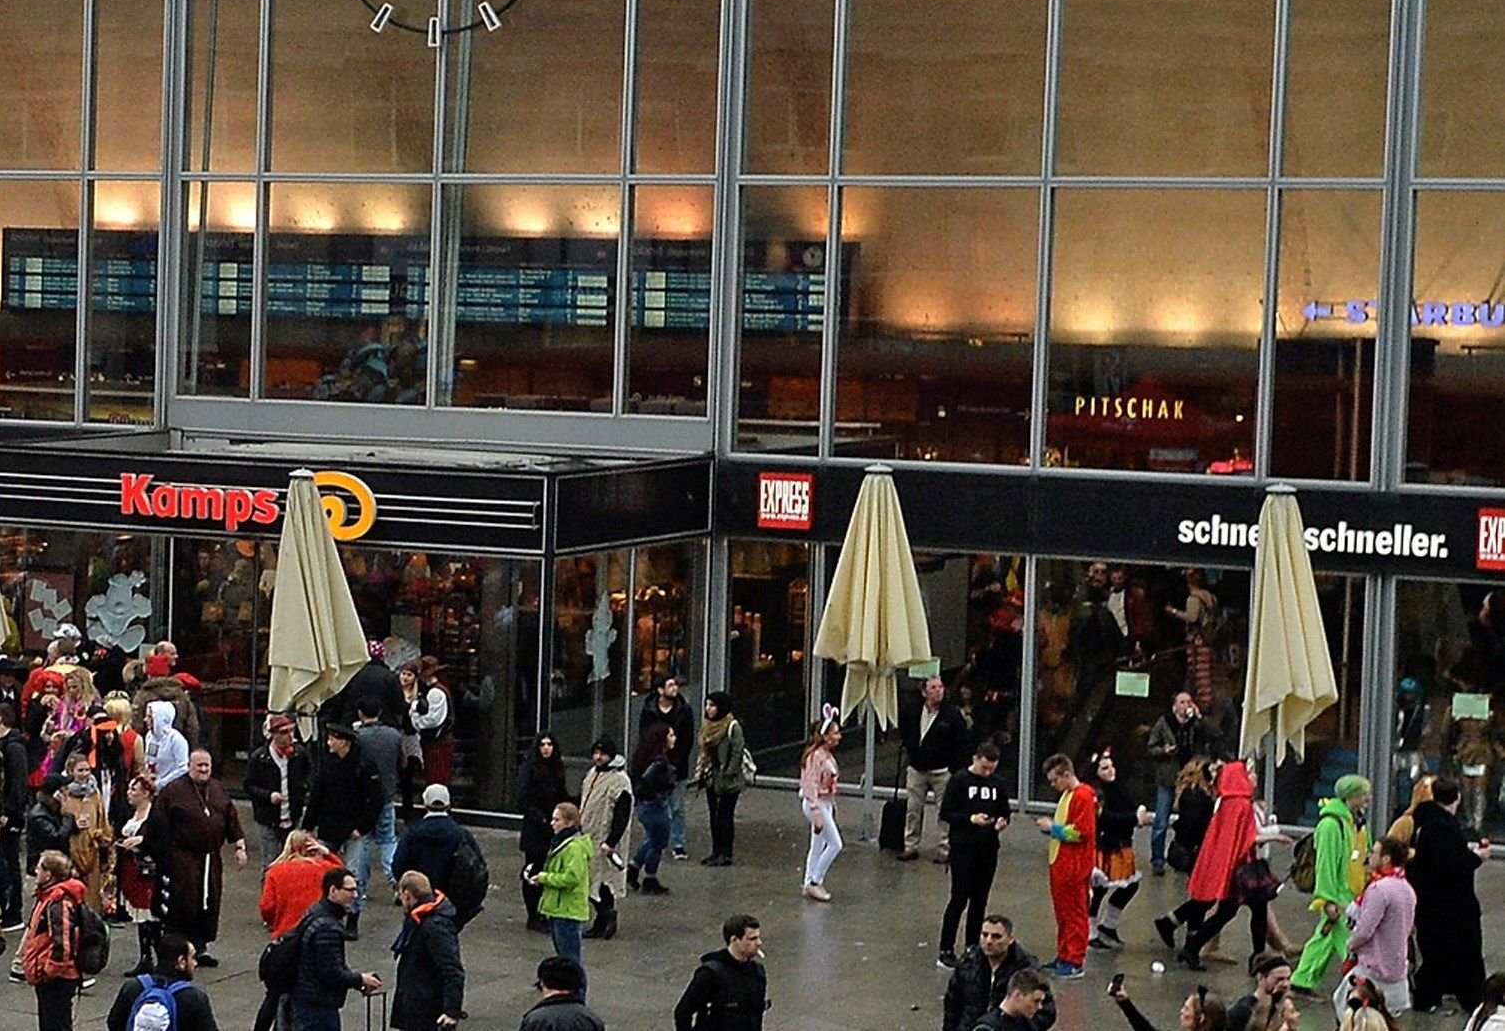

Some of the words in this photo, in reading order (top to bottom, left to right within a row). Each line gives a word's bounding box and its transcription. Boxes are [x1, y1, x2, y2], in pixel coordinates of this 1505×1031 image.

[1075, 396, 1184, 419] PITSCHAK
[119, 472, 280, 532] Kamps
[760, 479, 810, 514] EXPRESS
[1303, 520, 1449, 559] schneller.
